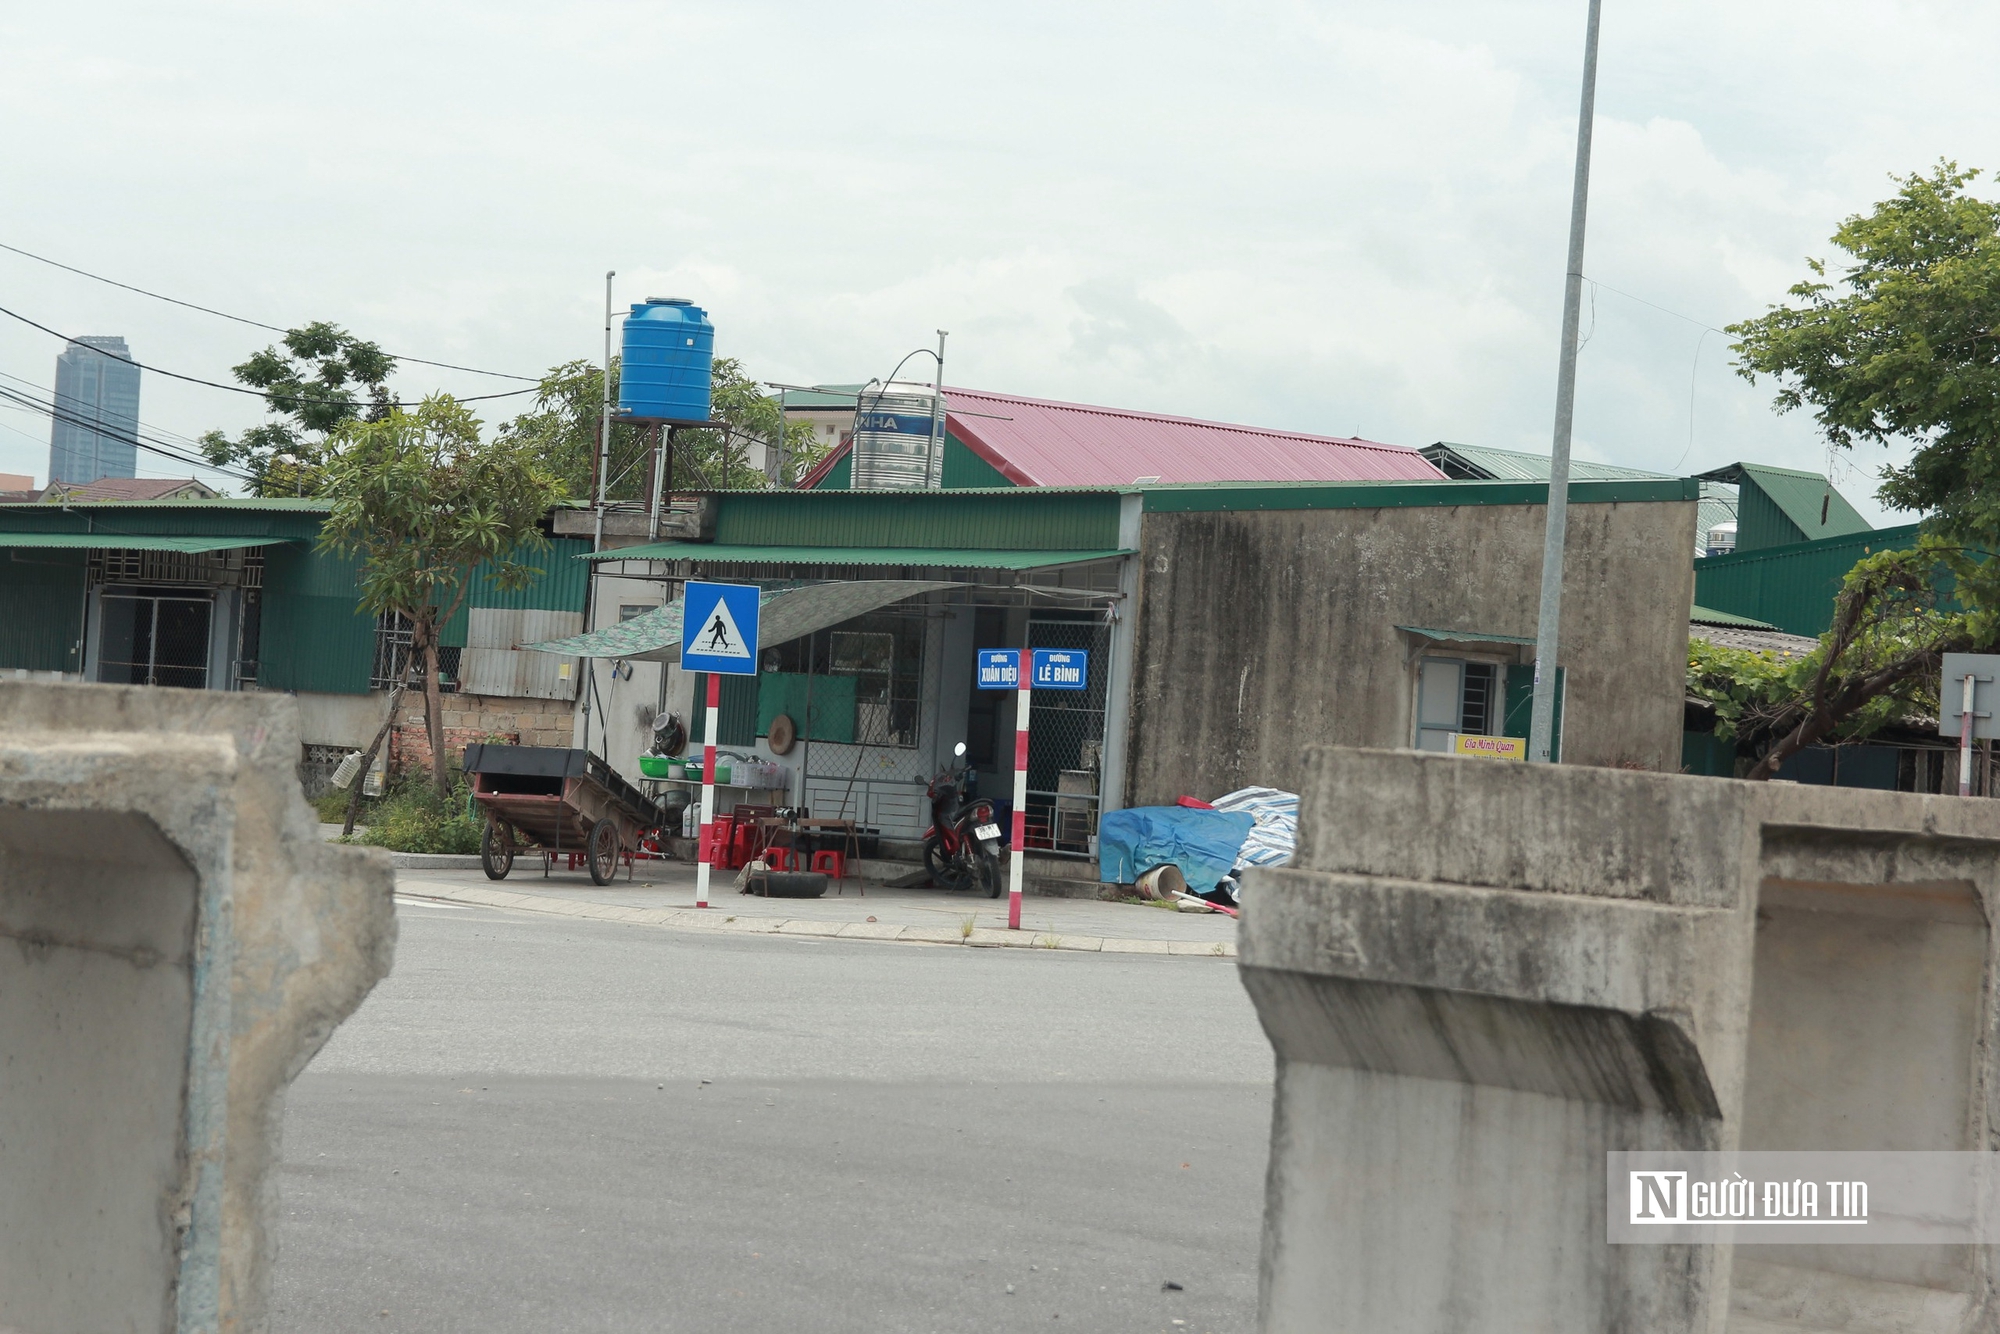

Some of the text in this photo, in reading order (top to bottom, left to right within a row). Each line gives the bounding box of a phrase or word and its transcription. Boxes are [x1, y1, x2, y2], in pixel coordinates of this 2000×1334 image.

[1049, 652, 1071, 663] ĐƯỜNG
[981, 664, 1017, 685] XUÂN DIỆU
[1039, 664, 1079, 682] LÊ BÌNH
[1464, 738, 1477, 749] Gia
[1478, 739, 1495, 750] Minh
